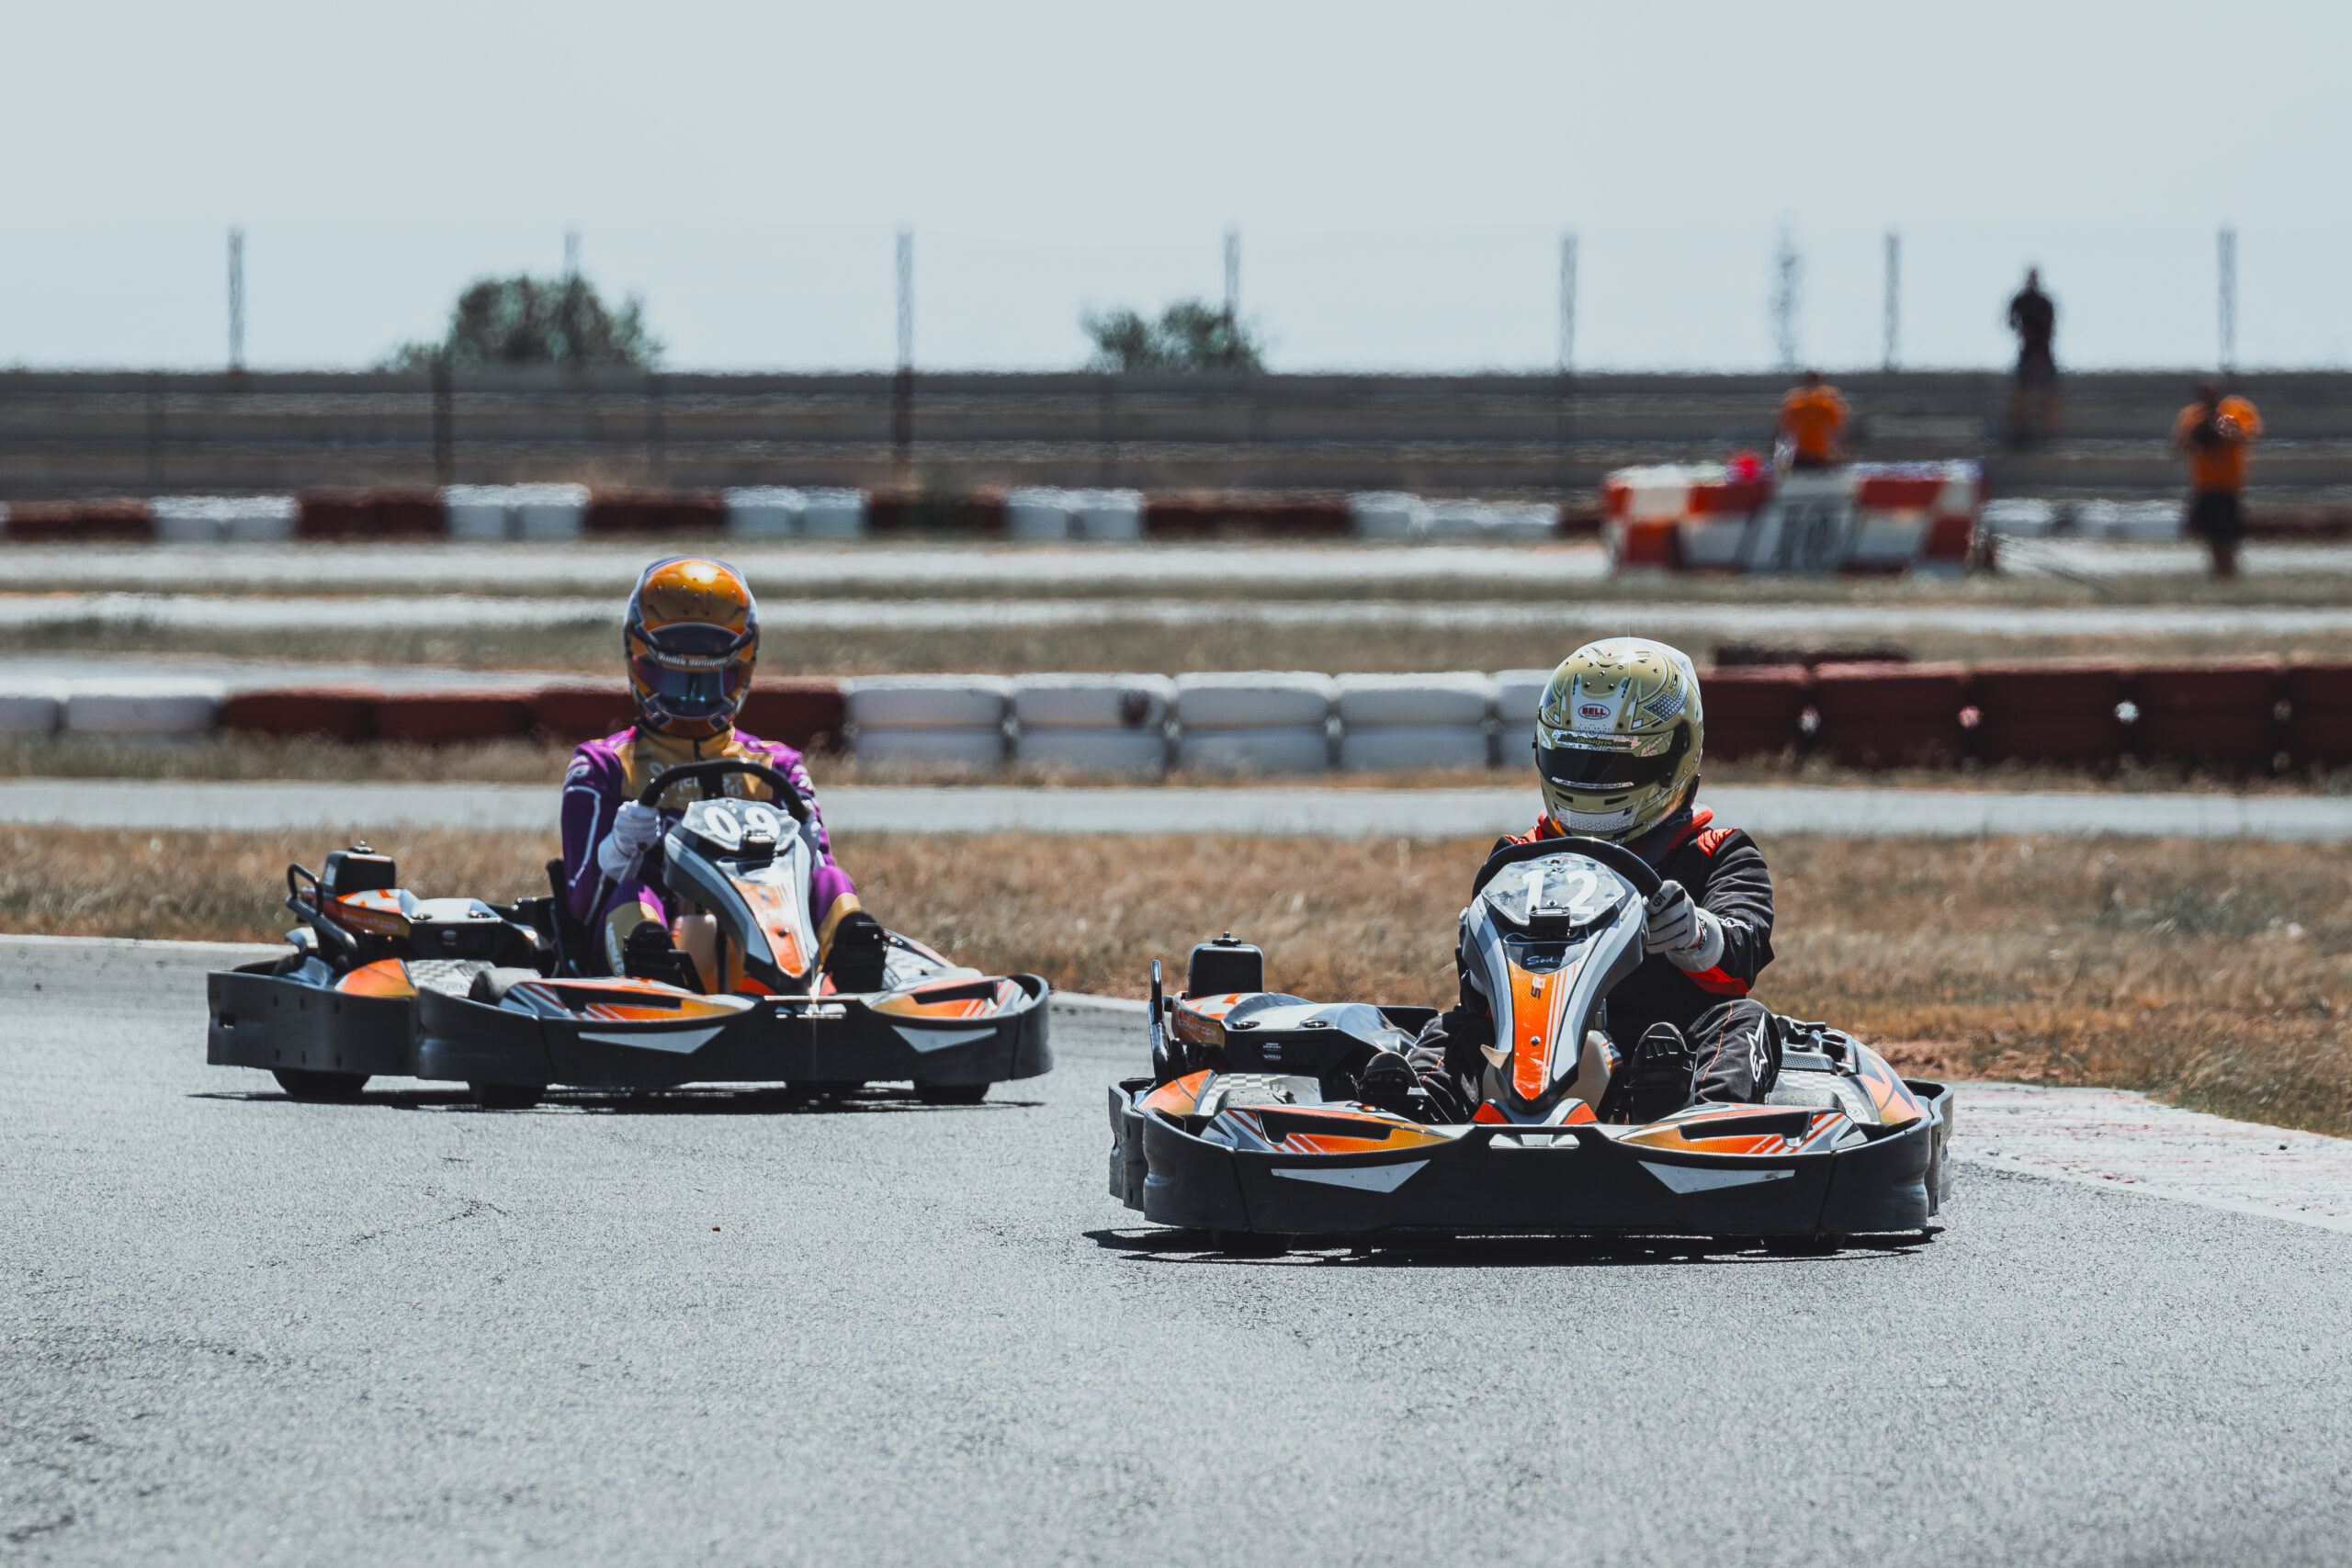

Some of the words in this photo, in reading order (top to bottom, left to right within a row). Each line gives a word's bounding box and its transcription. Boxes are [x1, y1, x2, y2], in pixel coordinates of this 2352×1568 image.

[1581, 706, 1606, 716] BELL
[704, 806, 781, 842] 09
[1521, 869, 1598, 915] 12
